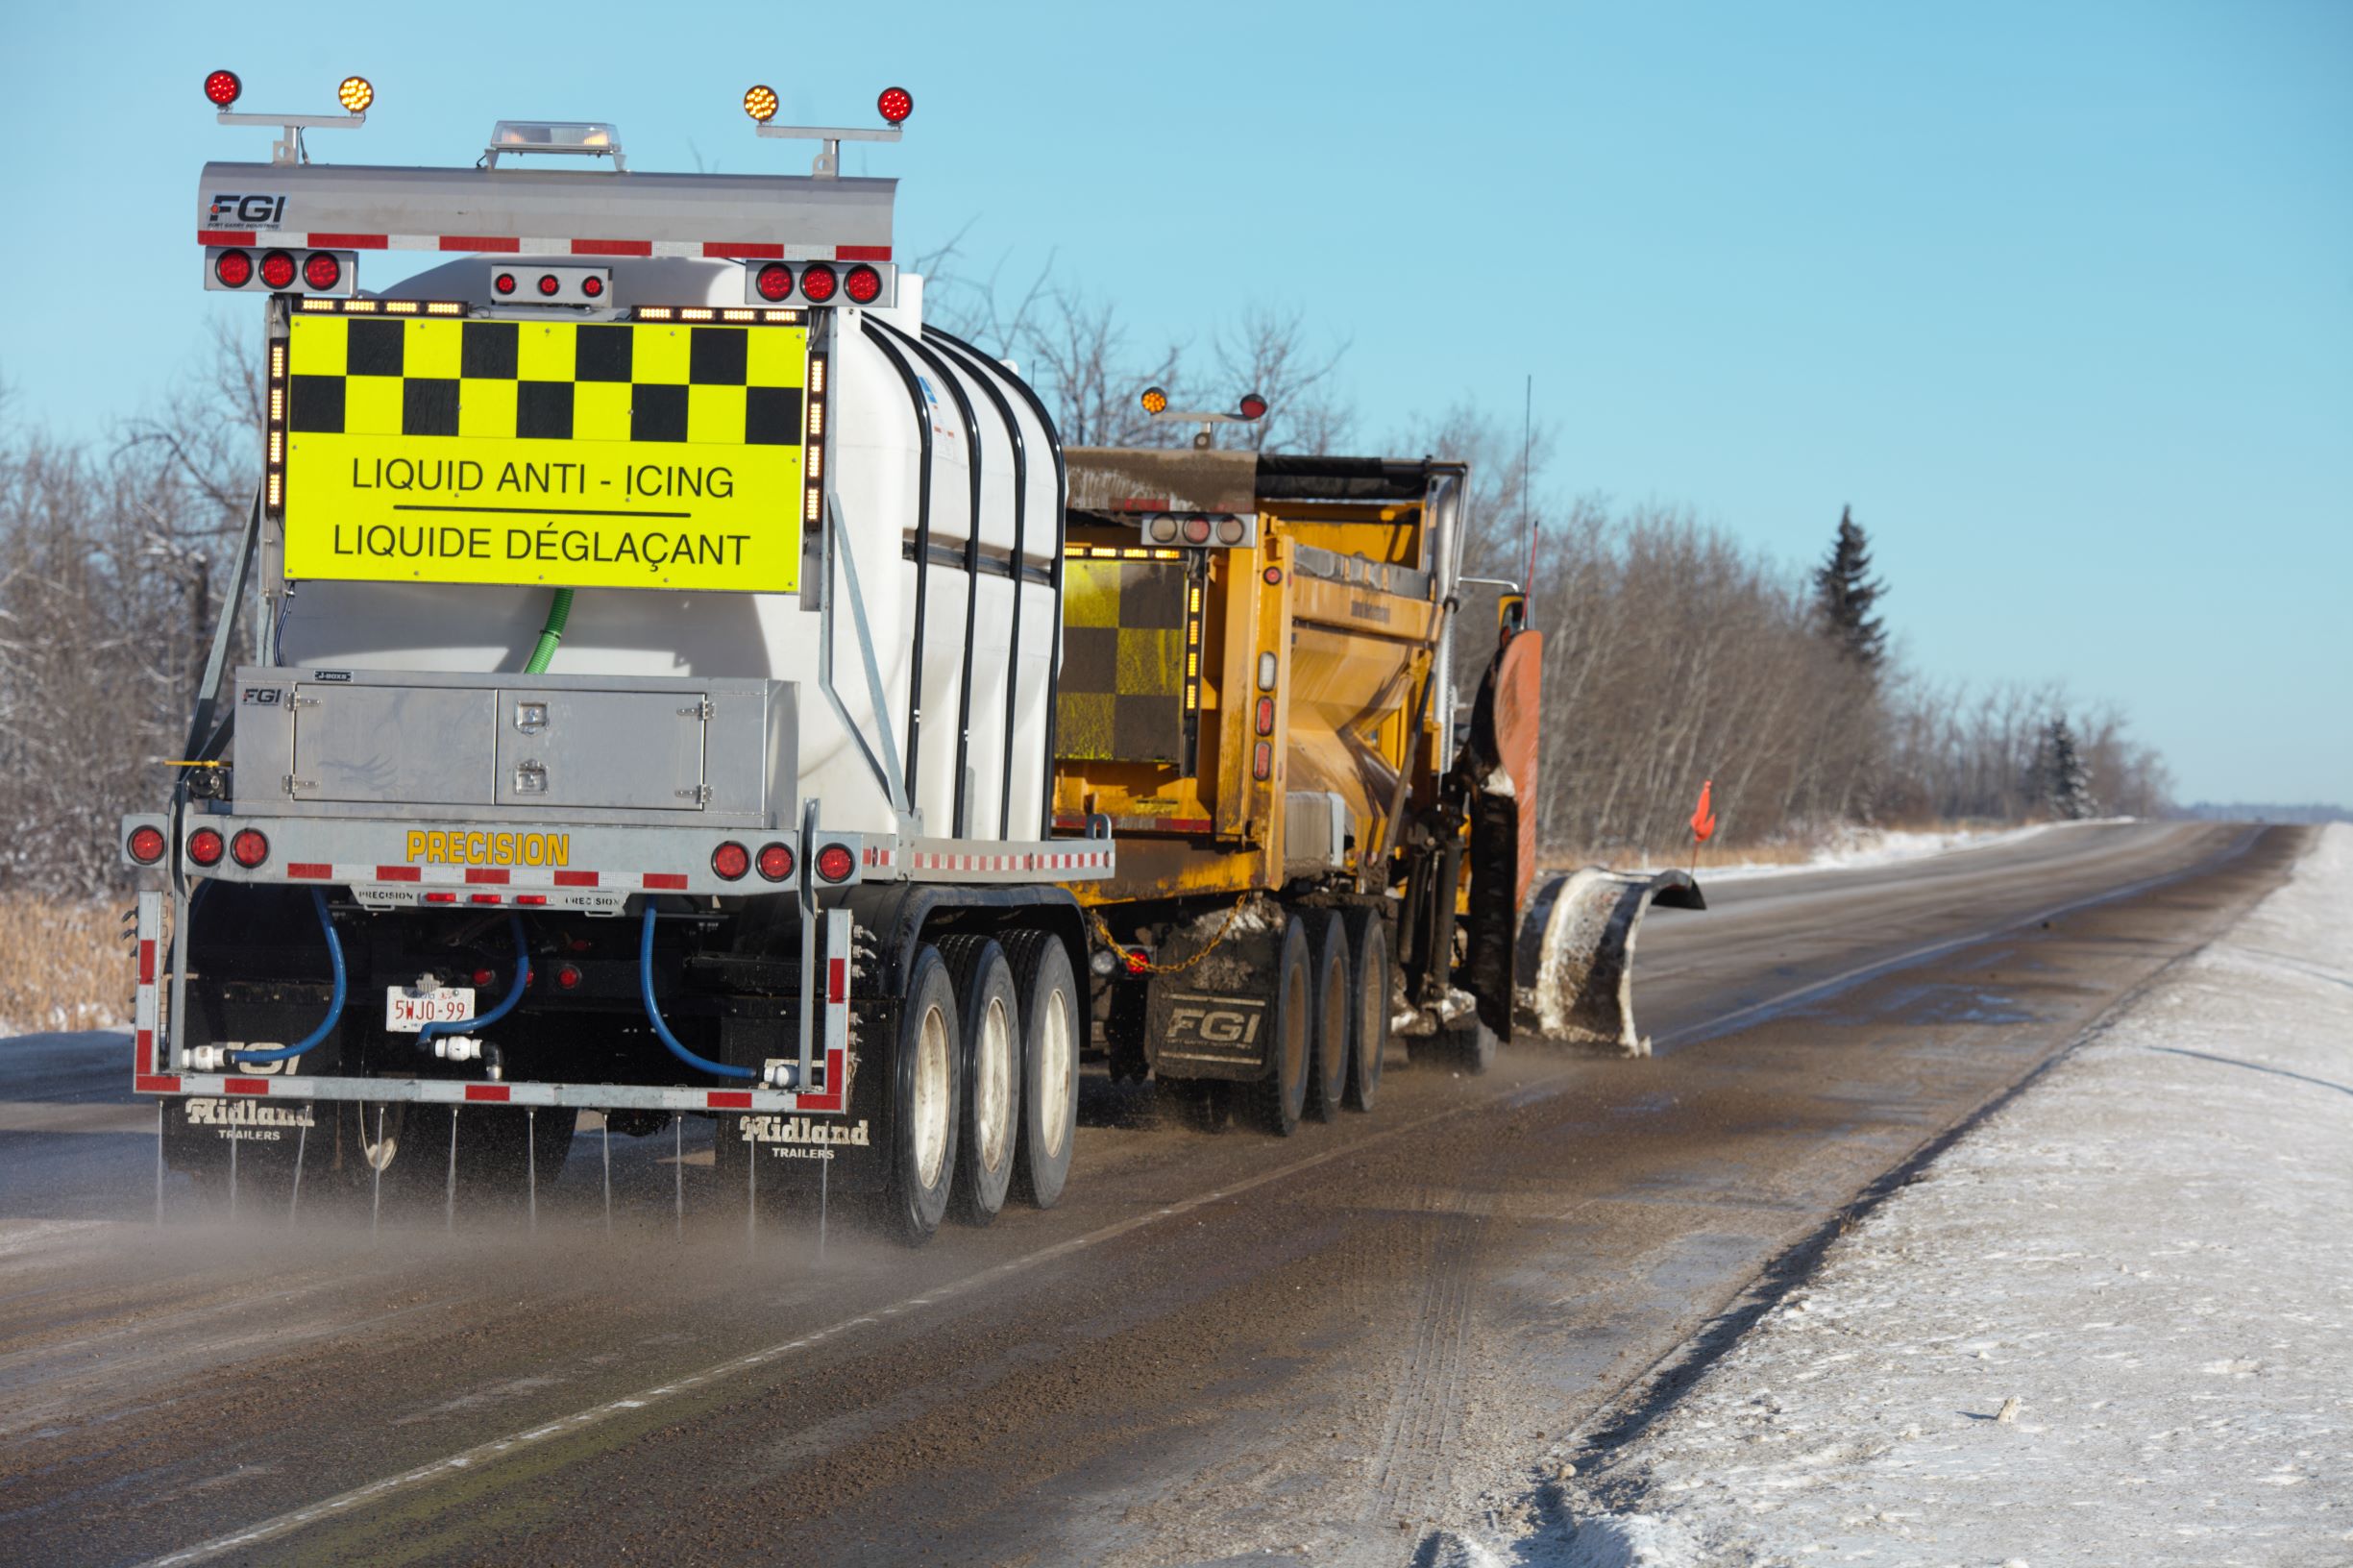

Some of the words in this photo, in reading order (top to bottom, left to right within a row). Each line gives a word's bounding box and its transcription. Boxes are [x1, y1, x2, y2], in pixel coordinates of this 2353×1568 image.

[209, 195, 286, 222] FGI
[353, 457, 483, 491] LIQUID
[497, 461, 585, 494] ANTI
[626, 464, 734, 498] ICING
[333, 524, 491, 558] LIQUIDE
[506, 522, 751, 573] DÉGLAÇANT
[242, 688, 282, 702] FGI
[406, 830, 570, 866] PRECISION
[358, 891, 413, 899] PRECISION
[1165, 1007, 1261, 1043] FGI
[184, 1097, 315, 1127] Midland
[218, 1129, 281, 1141] TRAILERS
[739, 1115, 870, 1146] Midland
[772, 1147, 835, 1160] TRAILERS
